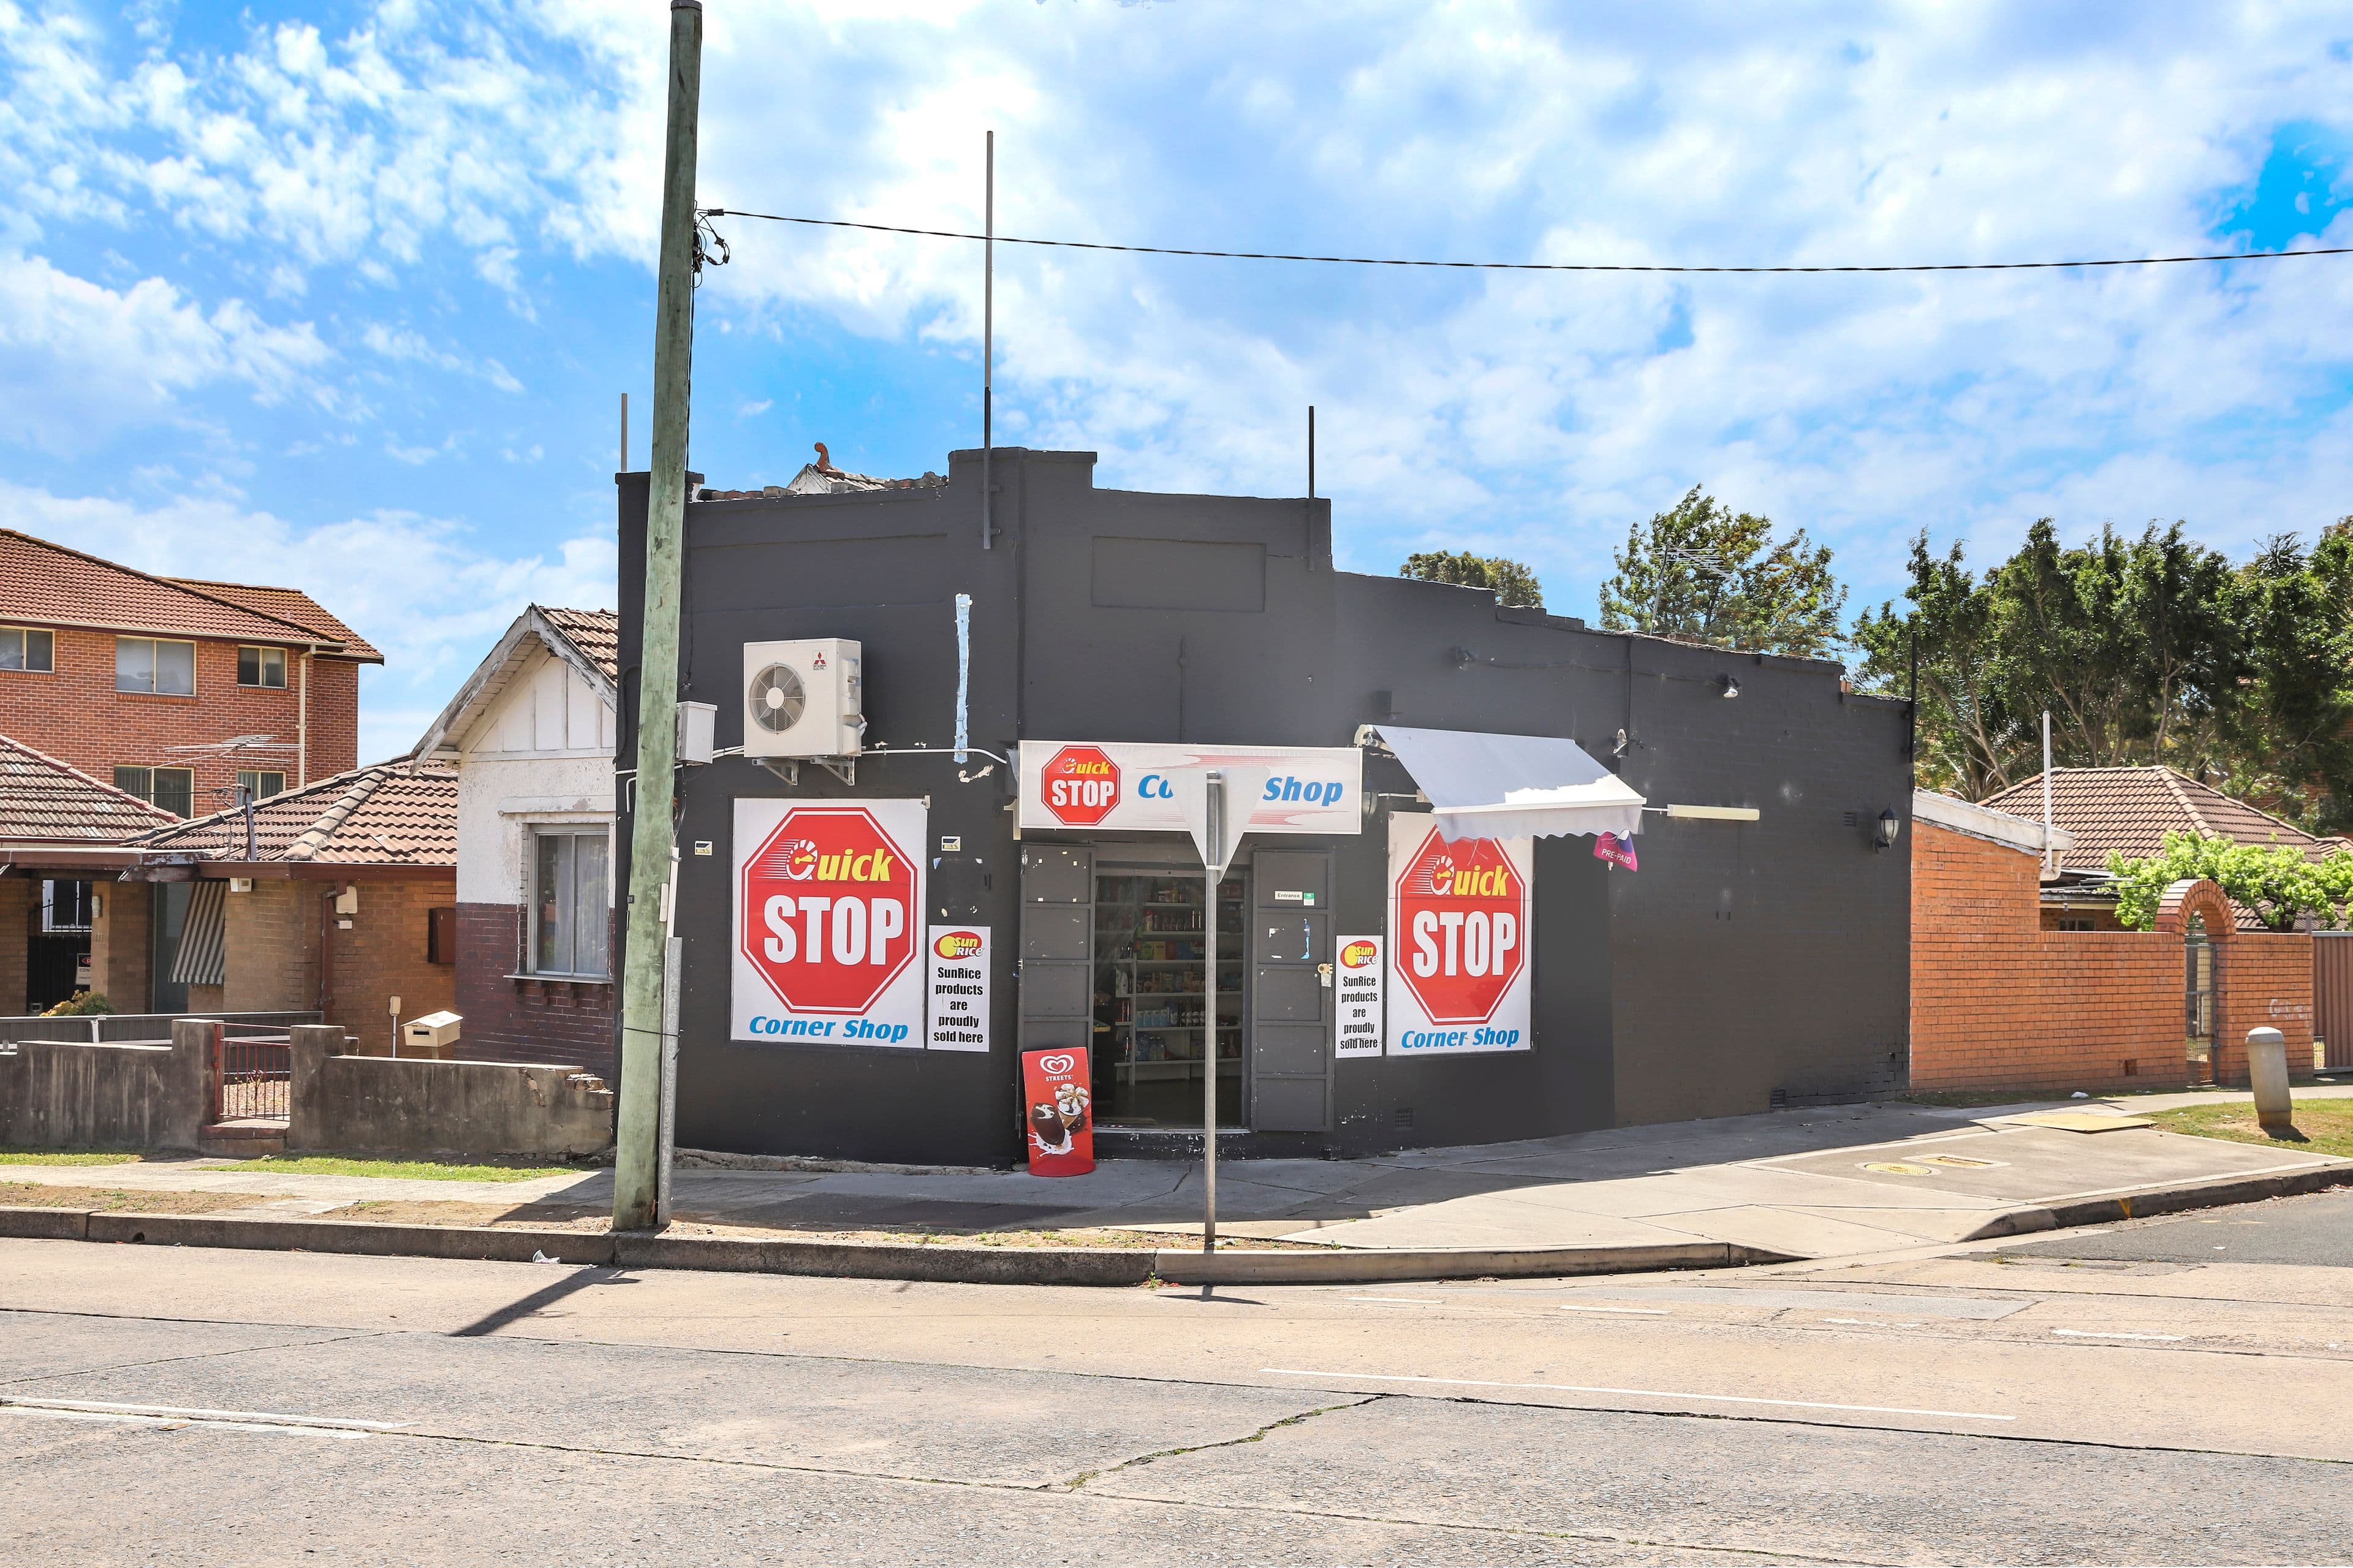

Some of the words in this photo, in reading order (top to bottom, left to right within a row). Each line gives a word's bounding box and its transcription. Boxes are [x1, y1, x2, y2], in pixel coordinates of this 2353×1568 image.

[1062, 758, 1110, 775] Quick
[1051, 779, 1115, 806] STOP
[1262, 776, 1343, 806] Shop
[786, 839, 894, 881] Quick
[1602, 849, 1631, 864] PRE-PAID
[1430, 855, 1509, 896] Quick
[763, 895, 904, 966] STOP
[1412, 911, 1516, 977] STOP
[938, 967, 981, 979] SunRice
[1343, 976, 1376, 987] SunRice
[935, 983, 983, 995] products
[1341, 992, 1377, 1003] products
[950, 1001, 968, 1010] are
[1352, 1009, 1366, 1018] are
[938, 1016, 979, 1028] proudly
[1344, 1022, 1375, 1034] proudly
[749, 1016, 836, 1037] Corner
[843, 1019, 908, 1043] Shop
[933, 1031, 956, 1042] sold
[958, 1031, 983, 1043] here
[1340, 1039, 1357, 1049] sold
[1359, 1038, 1378, 1048] here
[1401, 1030, 1468, 1048] Corner
[1472, 1027, 1520, 1048] Shop
